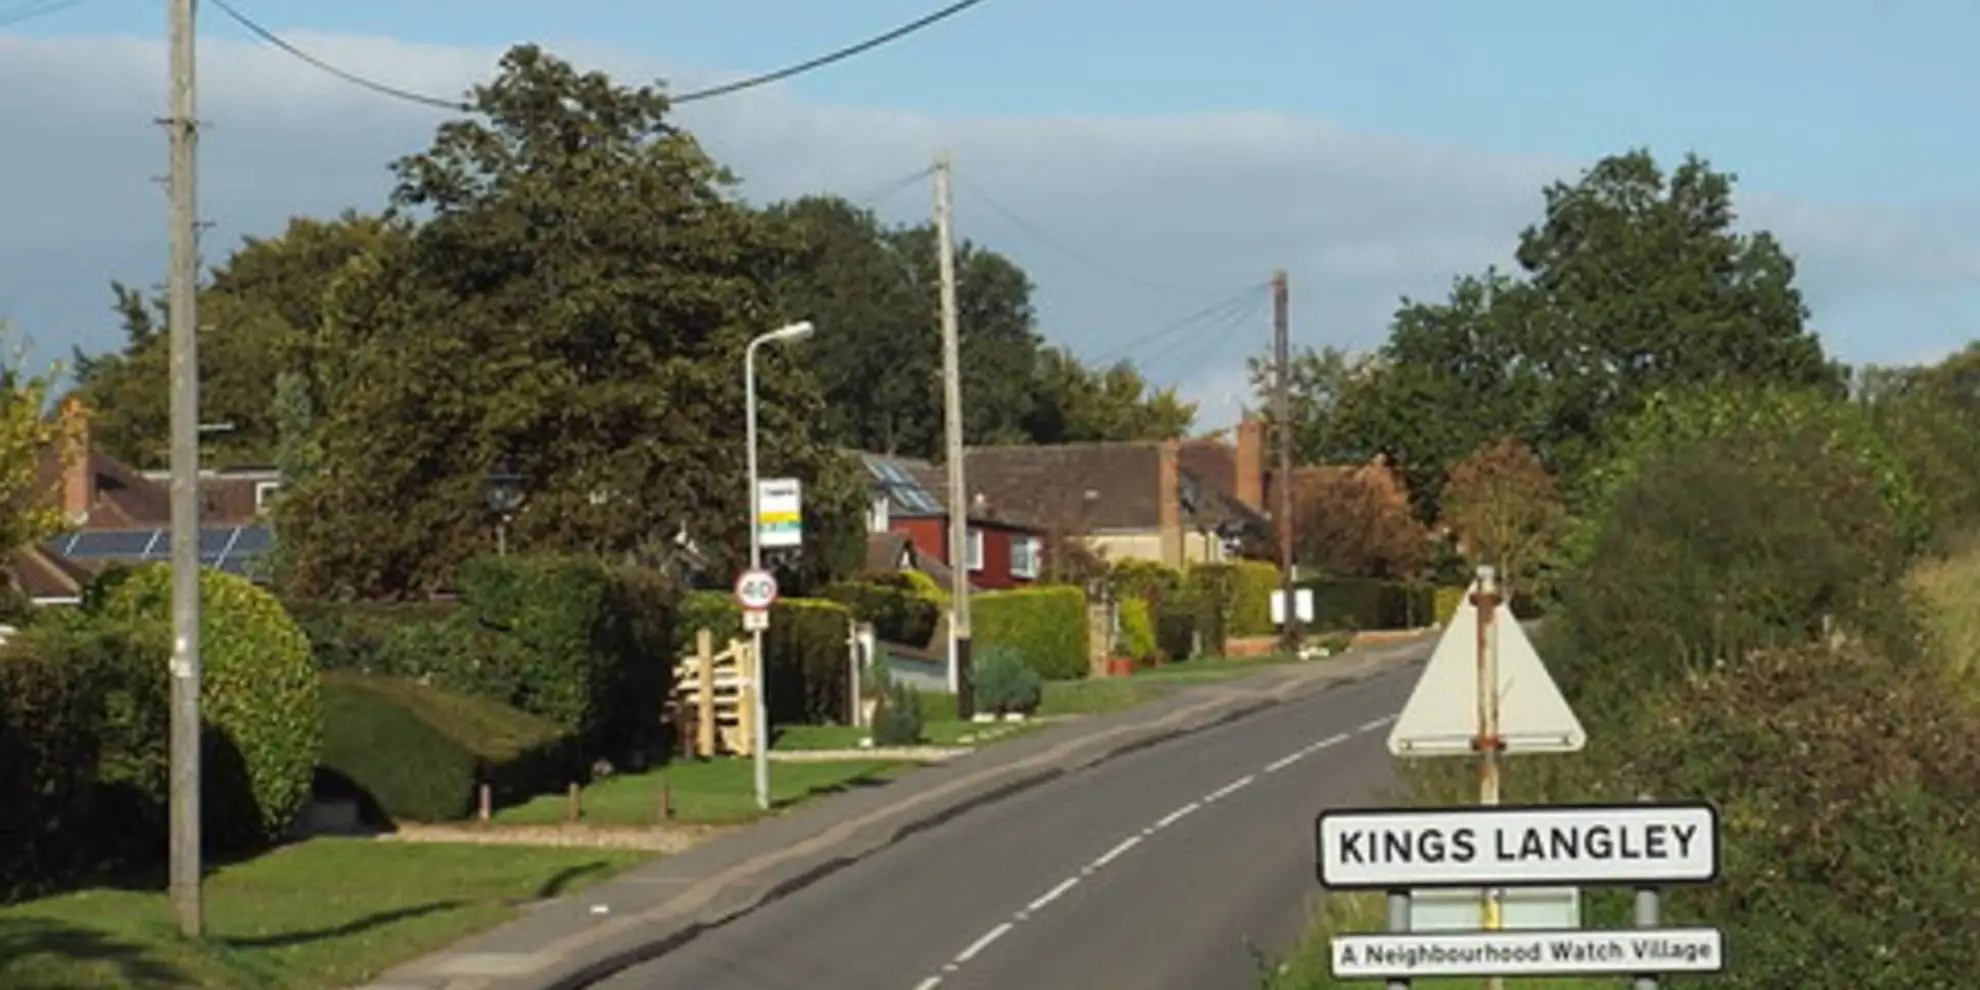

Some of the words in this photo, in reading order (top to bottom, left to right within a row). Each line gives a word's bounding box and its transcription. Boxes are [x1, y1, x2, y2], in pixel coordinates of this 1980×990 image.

[741, 579, 772, 599] 40
[1339, 828, 1477, 864] KINGS
[1496, 824, 1699, 861] LANGLEY
[1340, 945, 1358, 964] A
[1365, 942, 1542, 968] Neighbourhood
[1551, 940, 1623, 960] Watch
[1633, 938, 1713, 961] Village
